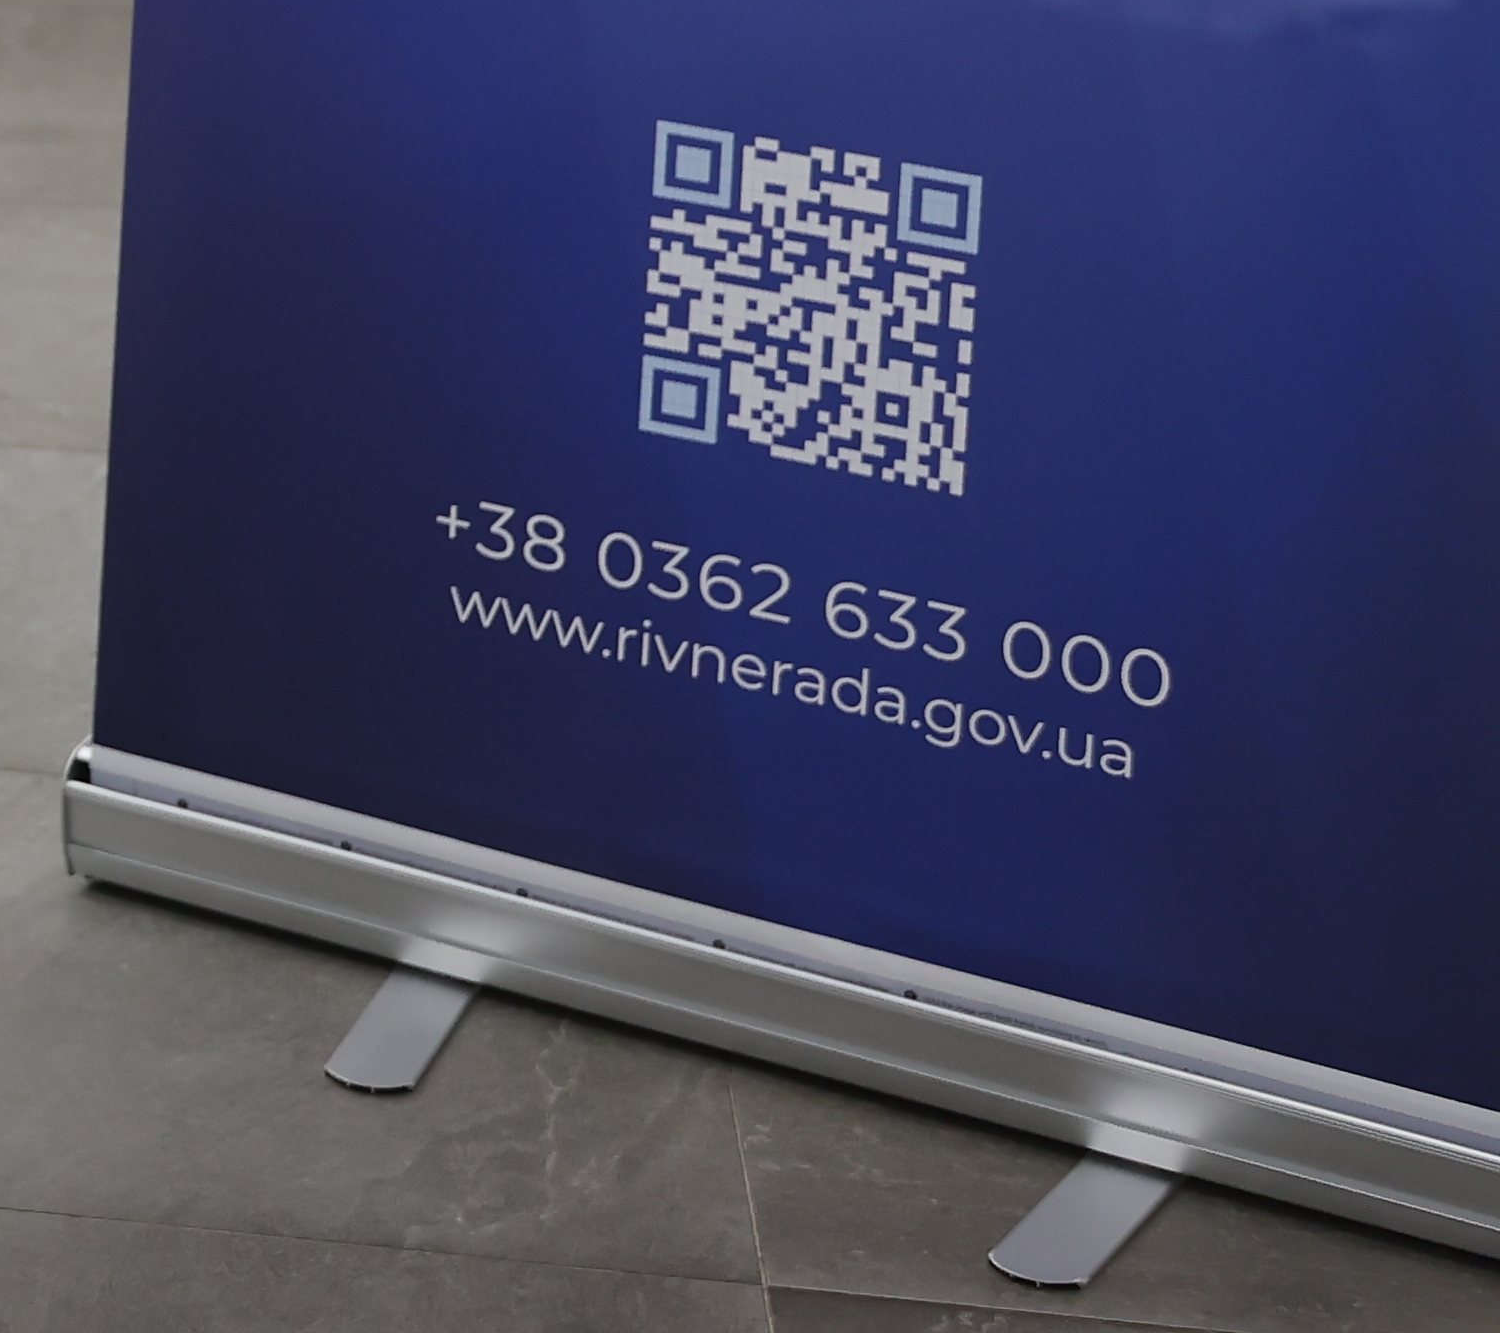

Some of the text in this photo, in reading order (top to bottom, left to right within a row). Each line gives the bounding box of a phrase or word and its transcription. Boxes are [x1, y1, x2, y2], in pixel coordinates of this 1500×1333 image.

[436, 501, 1171, 708] +38 0362 633 000
[450, 586, 1133, 779] www.rivnerada.gov.ua
